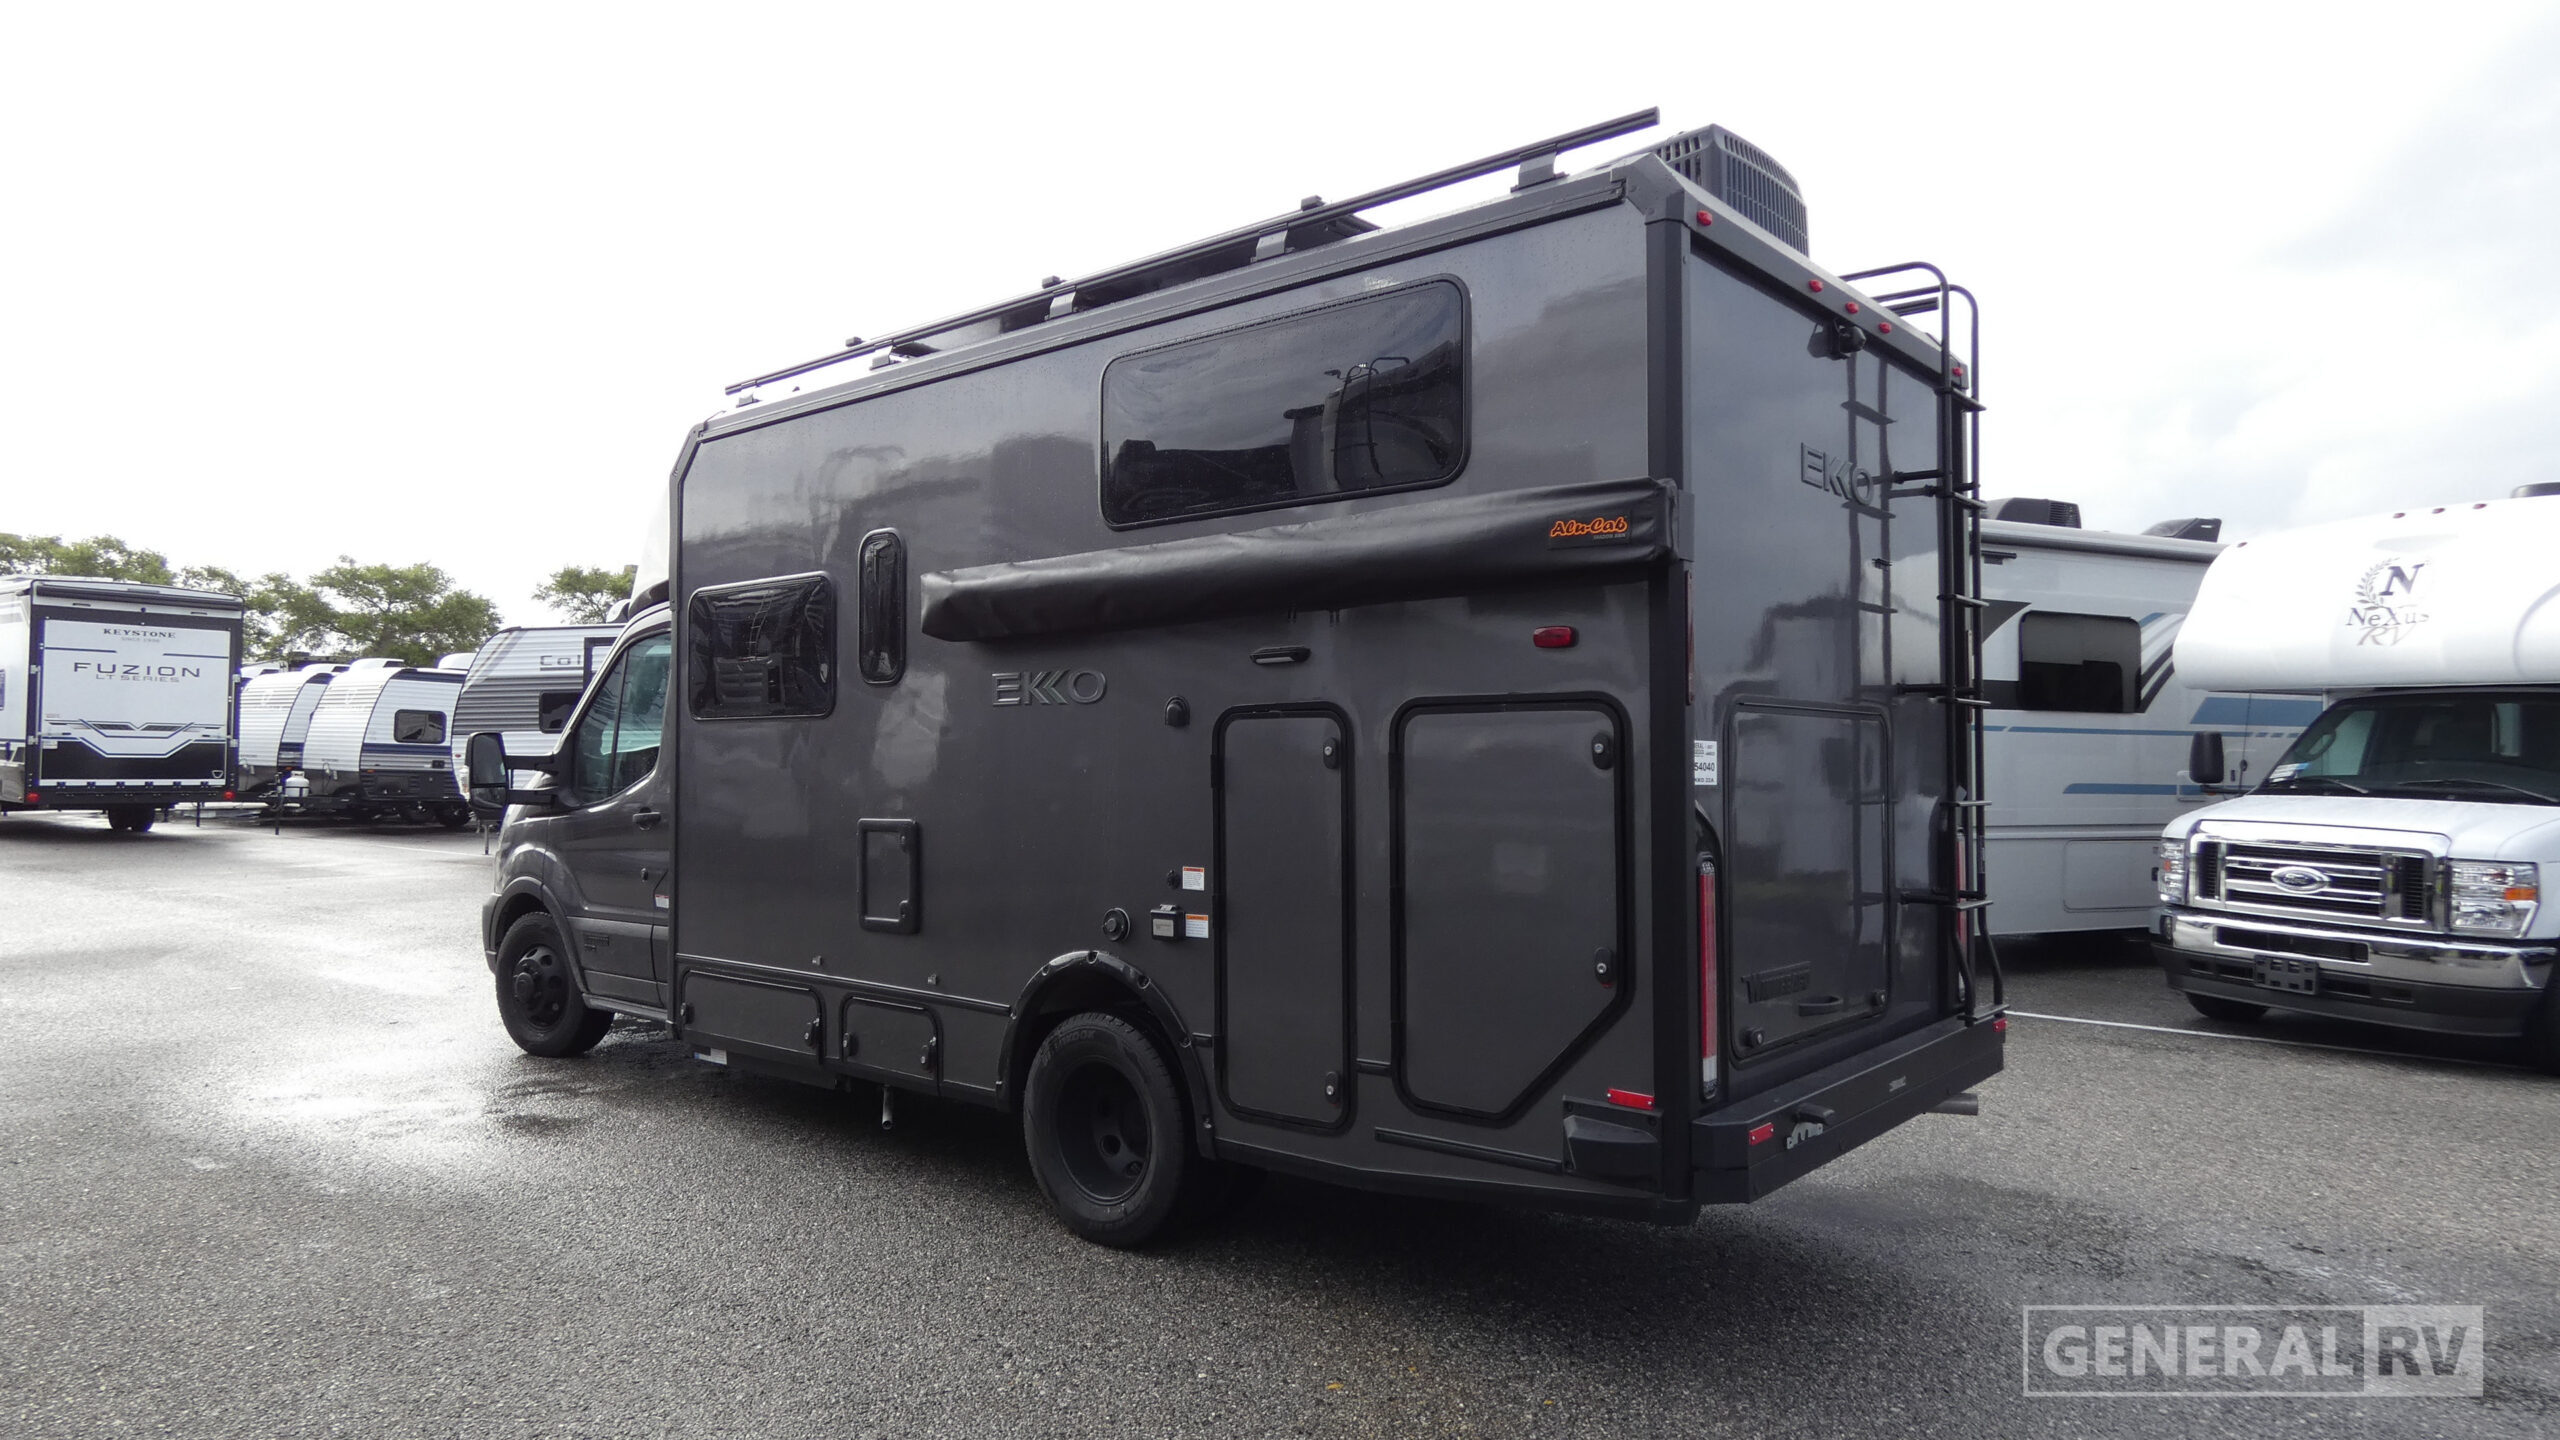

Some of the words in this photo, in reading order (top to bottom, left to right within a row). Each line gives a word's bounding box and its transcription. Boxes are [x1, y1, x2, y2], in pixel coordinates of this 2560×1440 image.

[1801, 442, 1874, 506] EKKO
[1550, 516, 1628, 537] Alu-Cab
[103, 628, 177, 639] KEYSTONE
[74, 662, 201, 678] FUZION
[120, 675, 180, 683] SERIES
[991, 668, 1107, 705] EKKO
